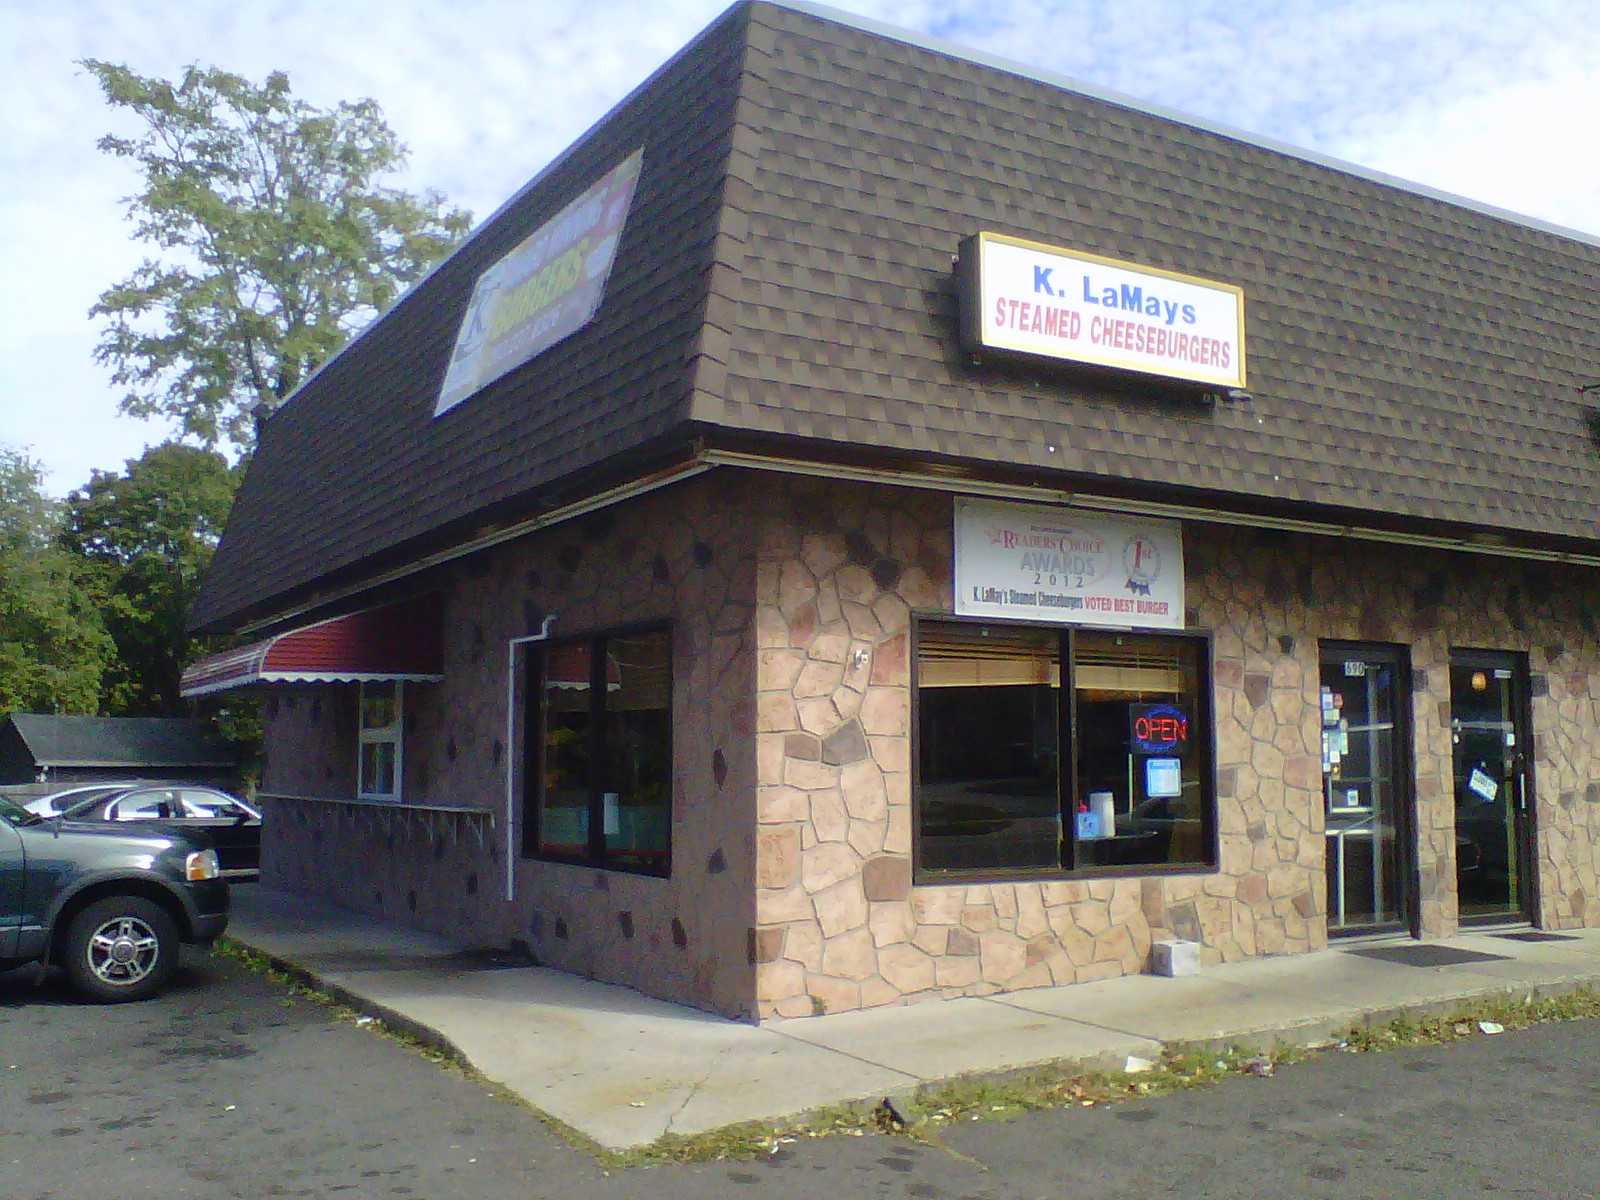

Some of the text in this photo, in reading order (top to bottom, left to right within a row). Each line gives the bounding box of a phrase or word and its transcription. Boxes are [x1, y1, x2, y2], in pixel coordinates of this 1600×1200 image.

[1033, 264, 1198, 326] K. LaMays
[995, 297, 1231, 369] STEAMED CHEESEBURGERS
[1020, 552, 1096, 577] AWARDS
[1084, 596, 1112, 611] VOTED
[1114, 598, 1135, 613] BEST
[1136, 600, 1169, 616] BURGER
[1135, 717, 1188, 740] OPEN
